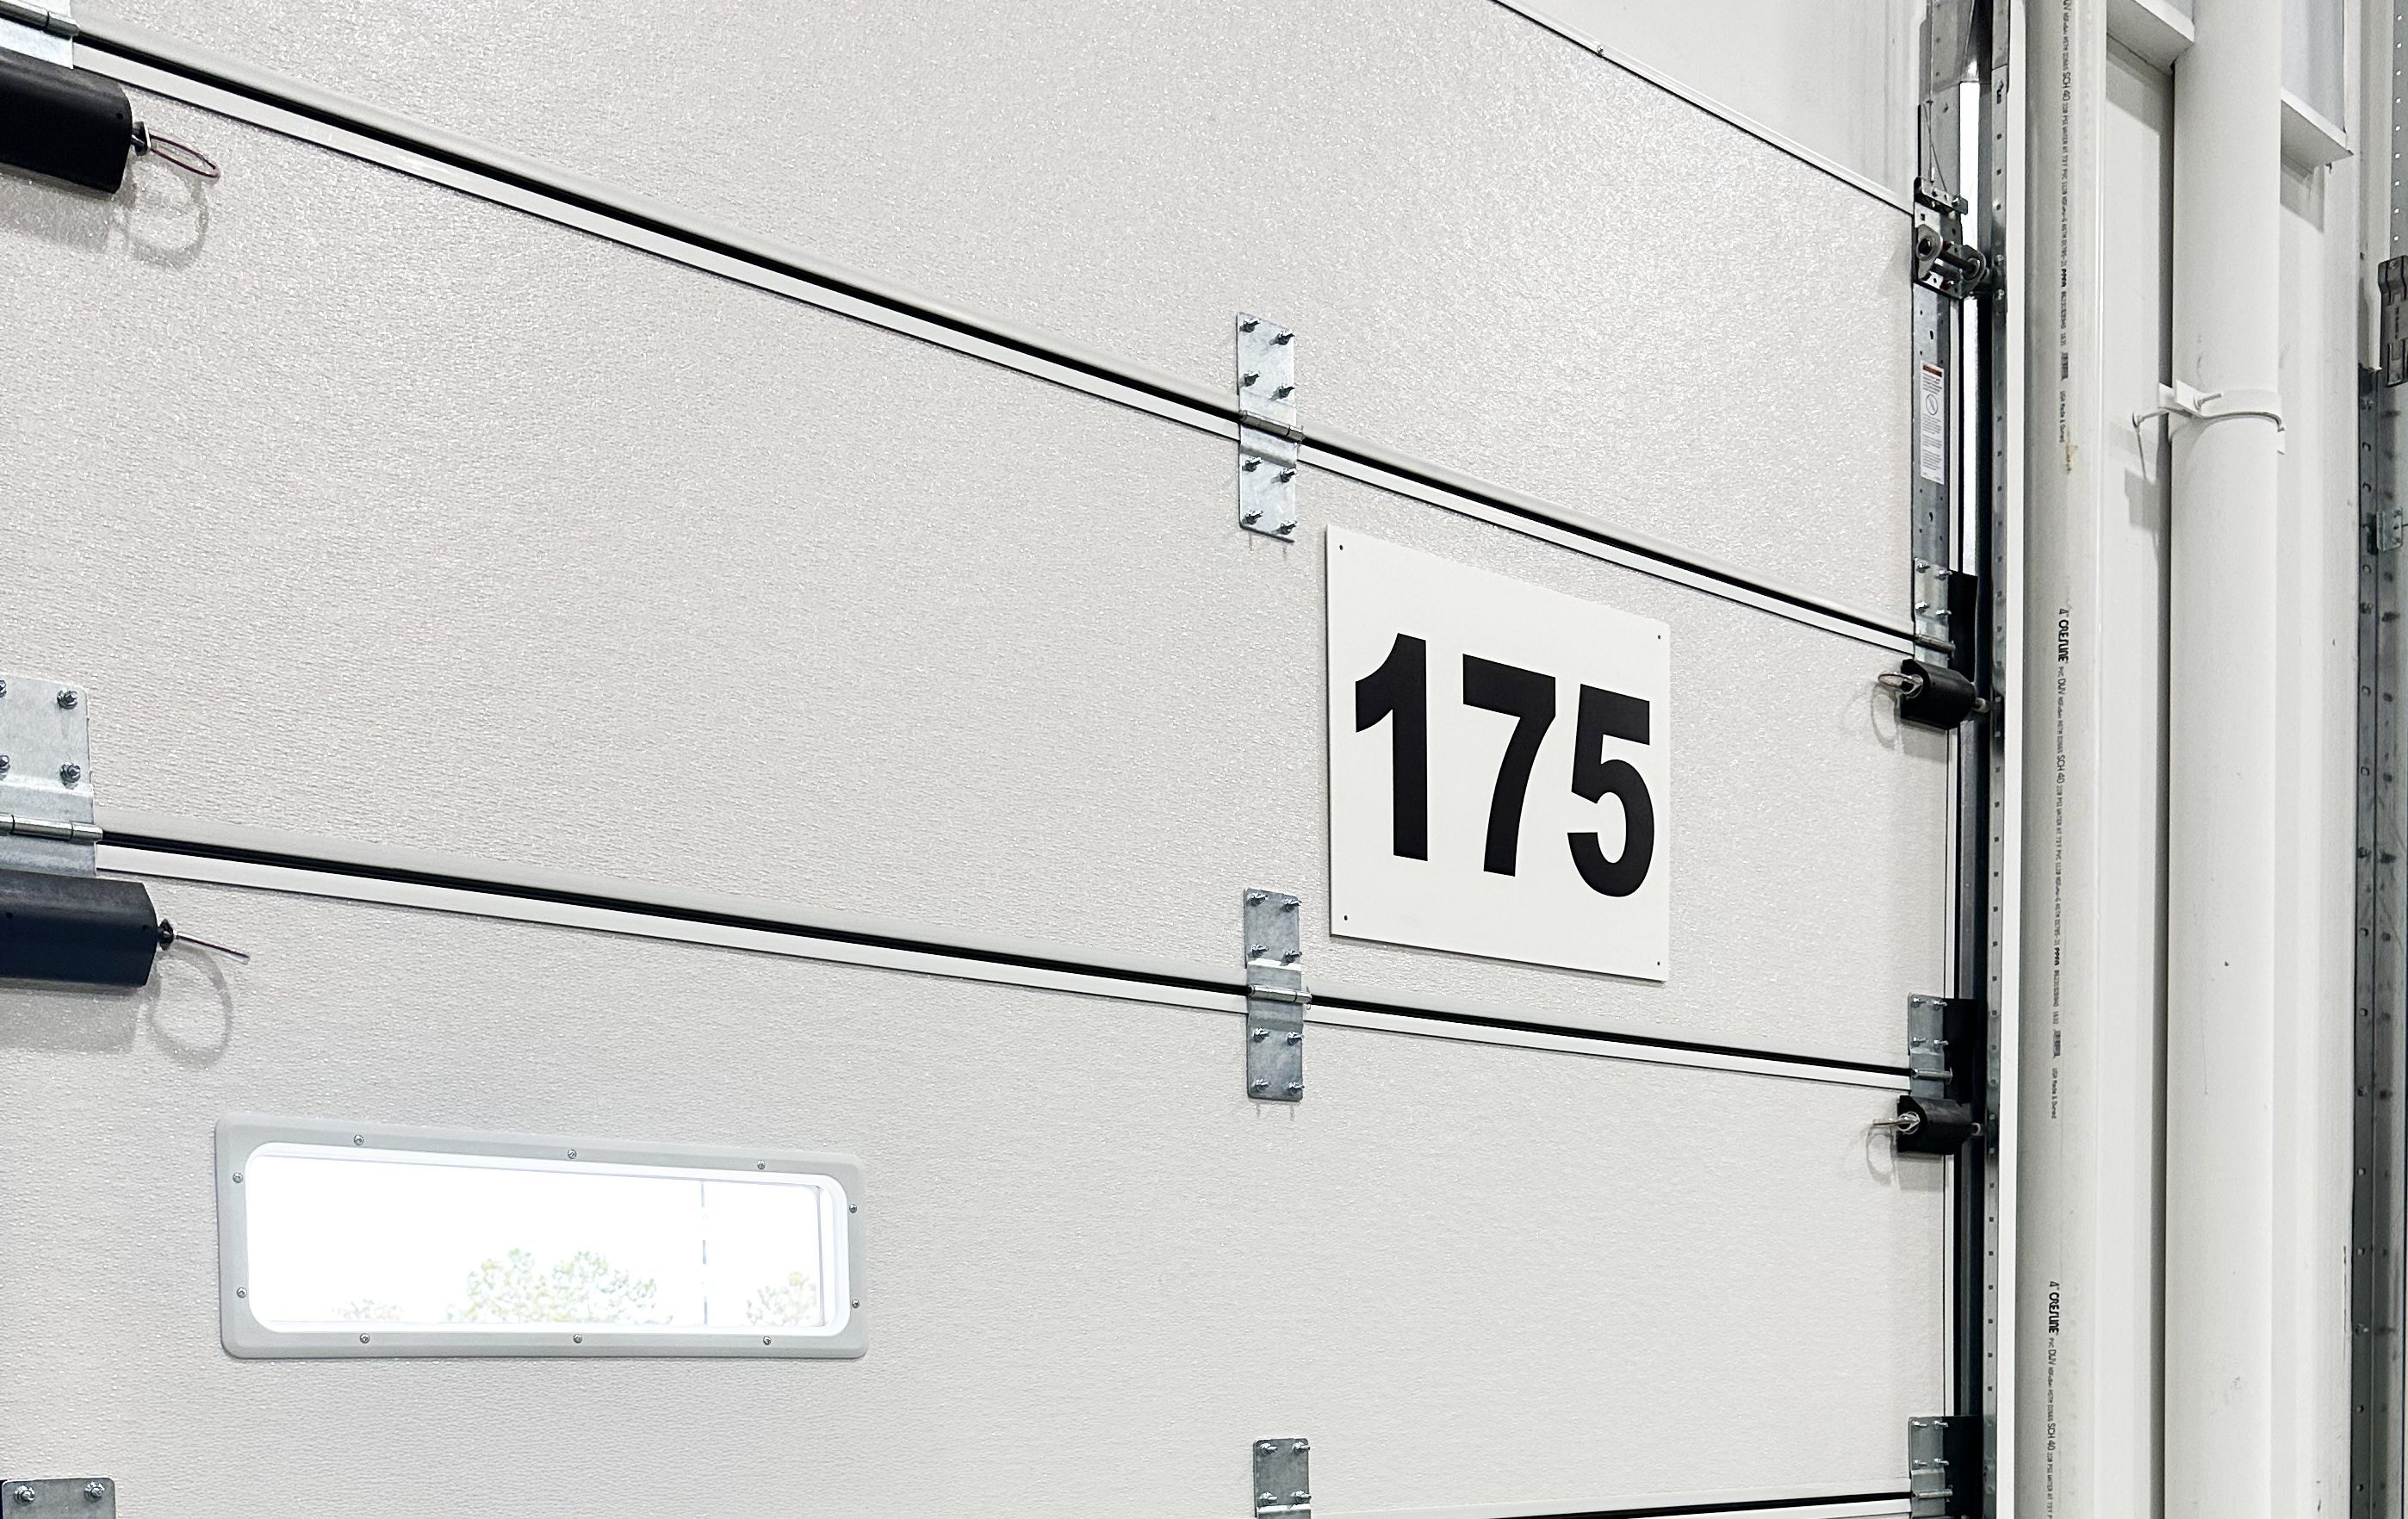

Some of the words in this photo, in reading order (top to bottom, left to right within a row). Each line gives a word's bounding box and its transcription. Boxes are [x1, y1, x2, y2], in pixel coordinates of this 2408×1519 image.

[2063, 71, 2071, 88] SCH
[2063, 90, 2070, 102] 40
[2057, 679, 2066, 694] DWV
[1356, 633, 1654, 897] 175
[2057, 754, 2065, 771] SCH
[2057, 772, 2065, 784] 40
[2048, 1349, 2057, 1365] DWV
[2047, 1423, 2056, 1438] SCH
[2047, 1440, 2056, 1451] 40
